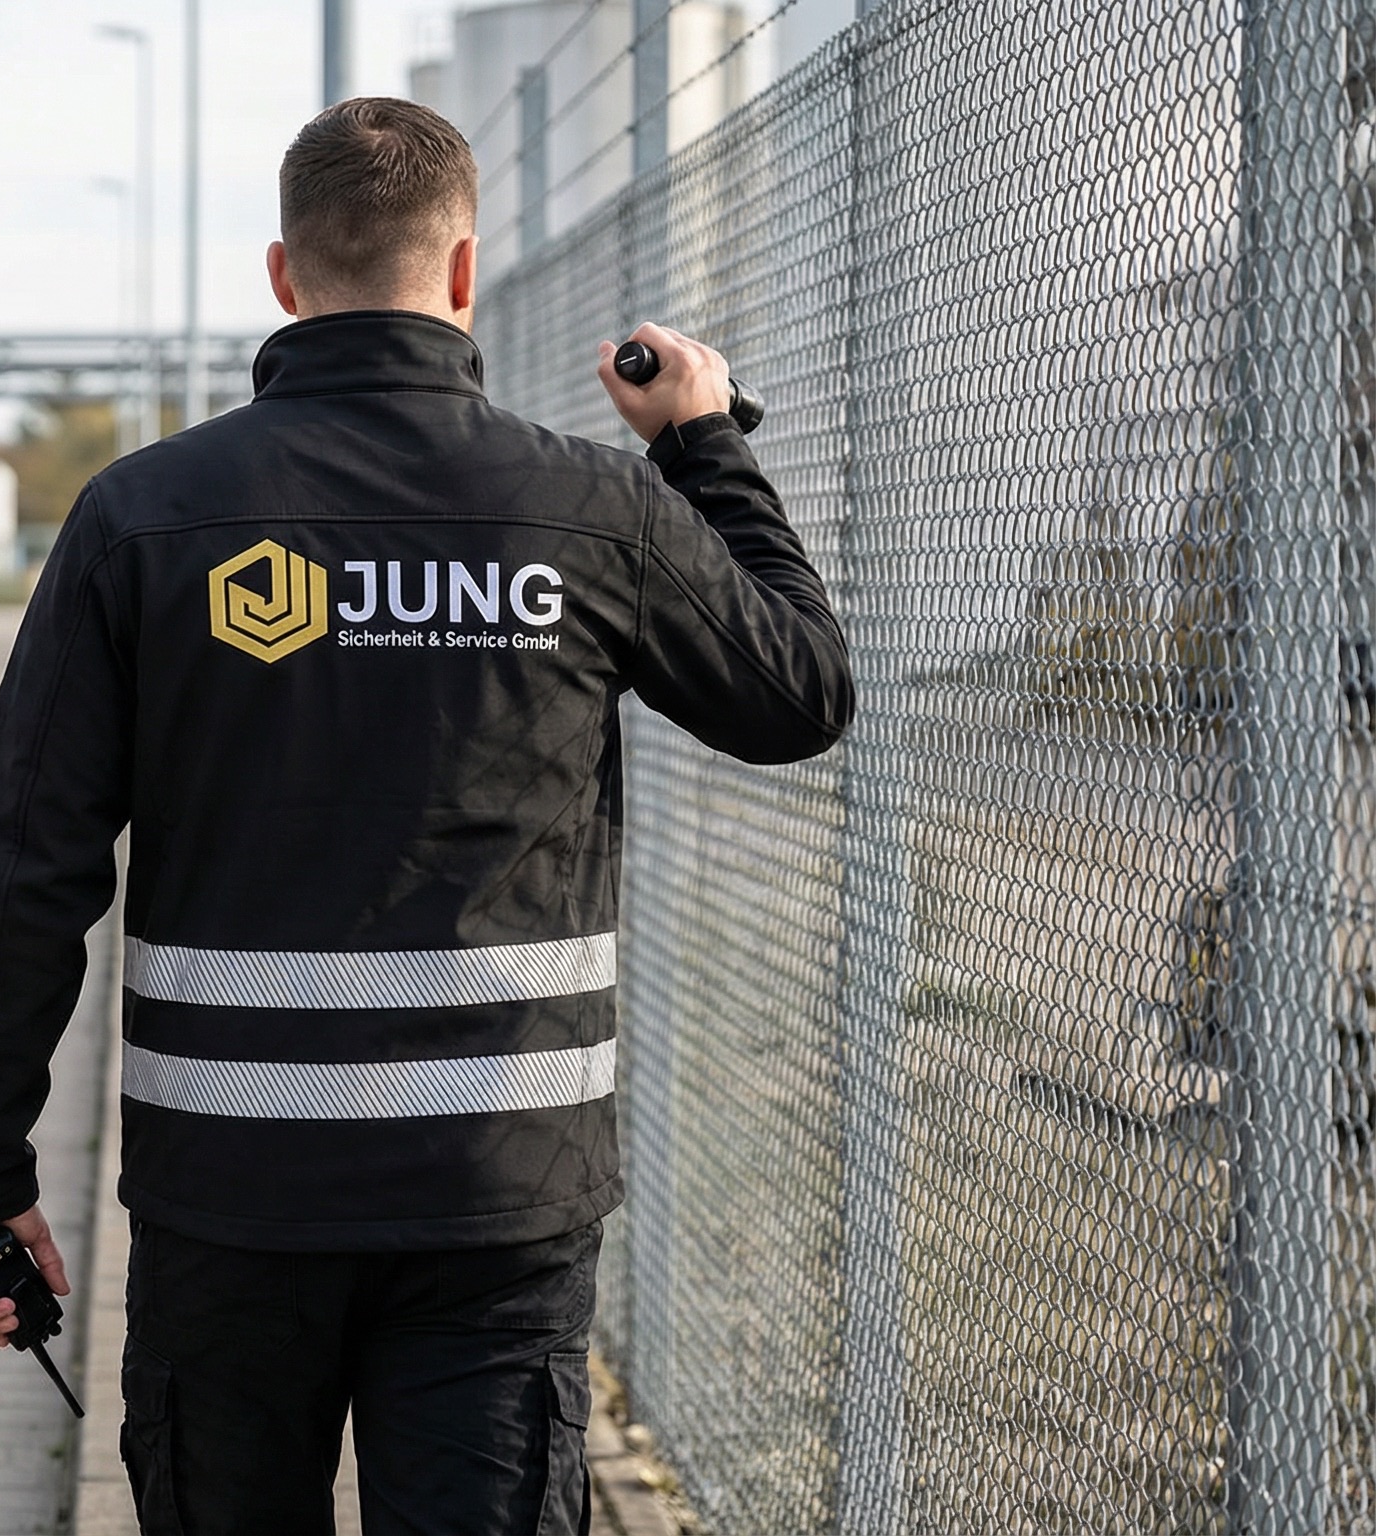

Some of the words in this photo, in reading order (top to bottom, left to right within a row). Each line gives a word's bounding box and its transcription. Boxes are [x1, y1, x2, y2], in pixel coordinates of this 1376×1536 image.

[337, 560, 564, 626] JUNG
[337, 629, 425, 648] Sicherheit
[428, 631, 441, 647] &
[445, 630, 508, 649] Service
[512, 632, 560, 651] GmbH
